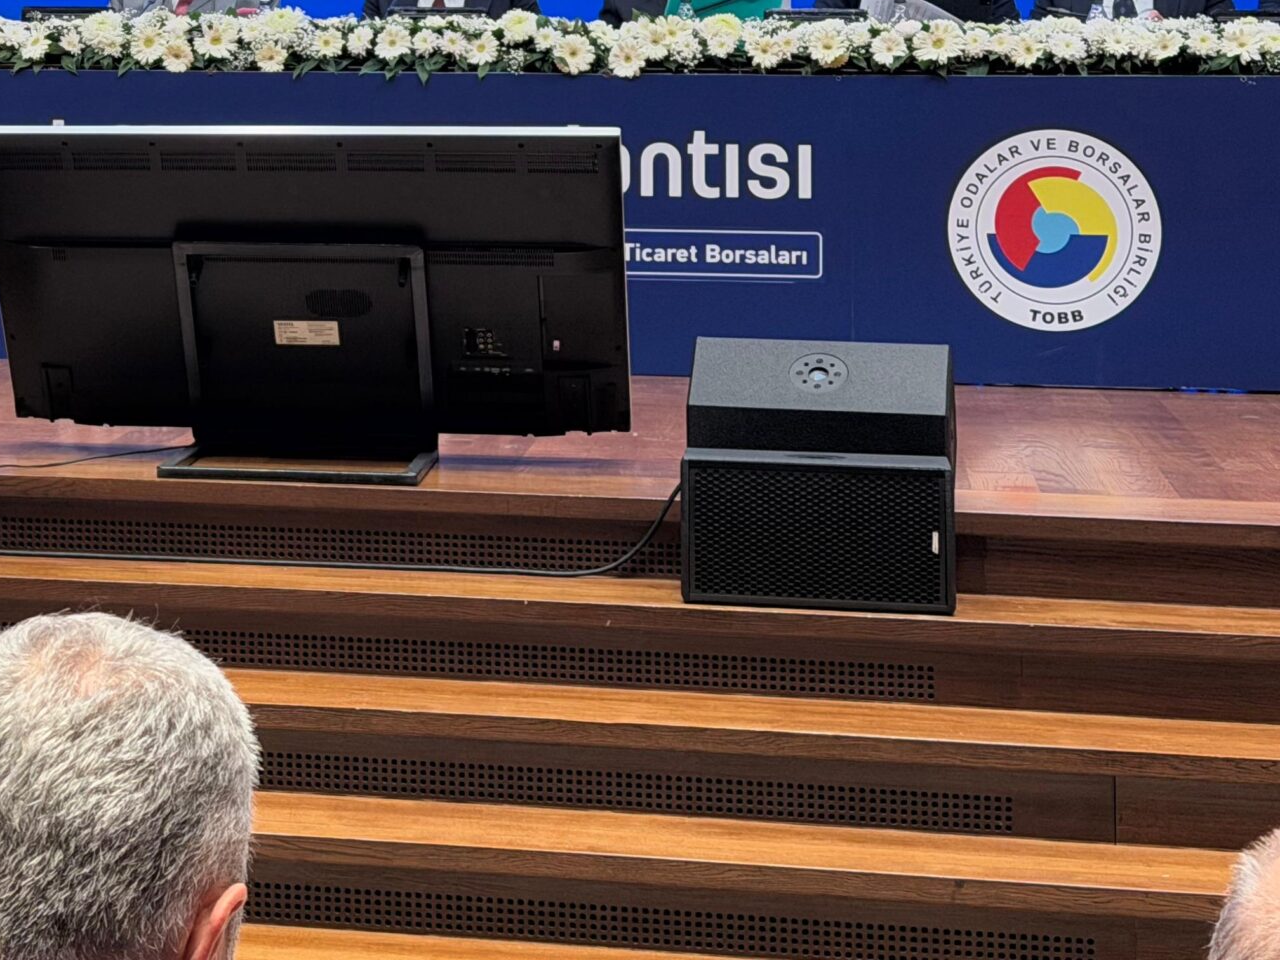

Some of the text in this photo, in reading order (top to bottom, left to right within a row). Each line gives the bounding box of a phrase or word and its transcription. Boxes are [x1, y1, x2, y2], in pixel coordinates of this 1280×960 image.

[956, 138, 1153, 306] TÜRKİYE ODALAR VE BORSALAR BİRLİĞİ
[625, 242, 807, 264] Ticaret Borsaları
[1029, 309, 1084, 324] TOBB
